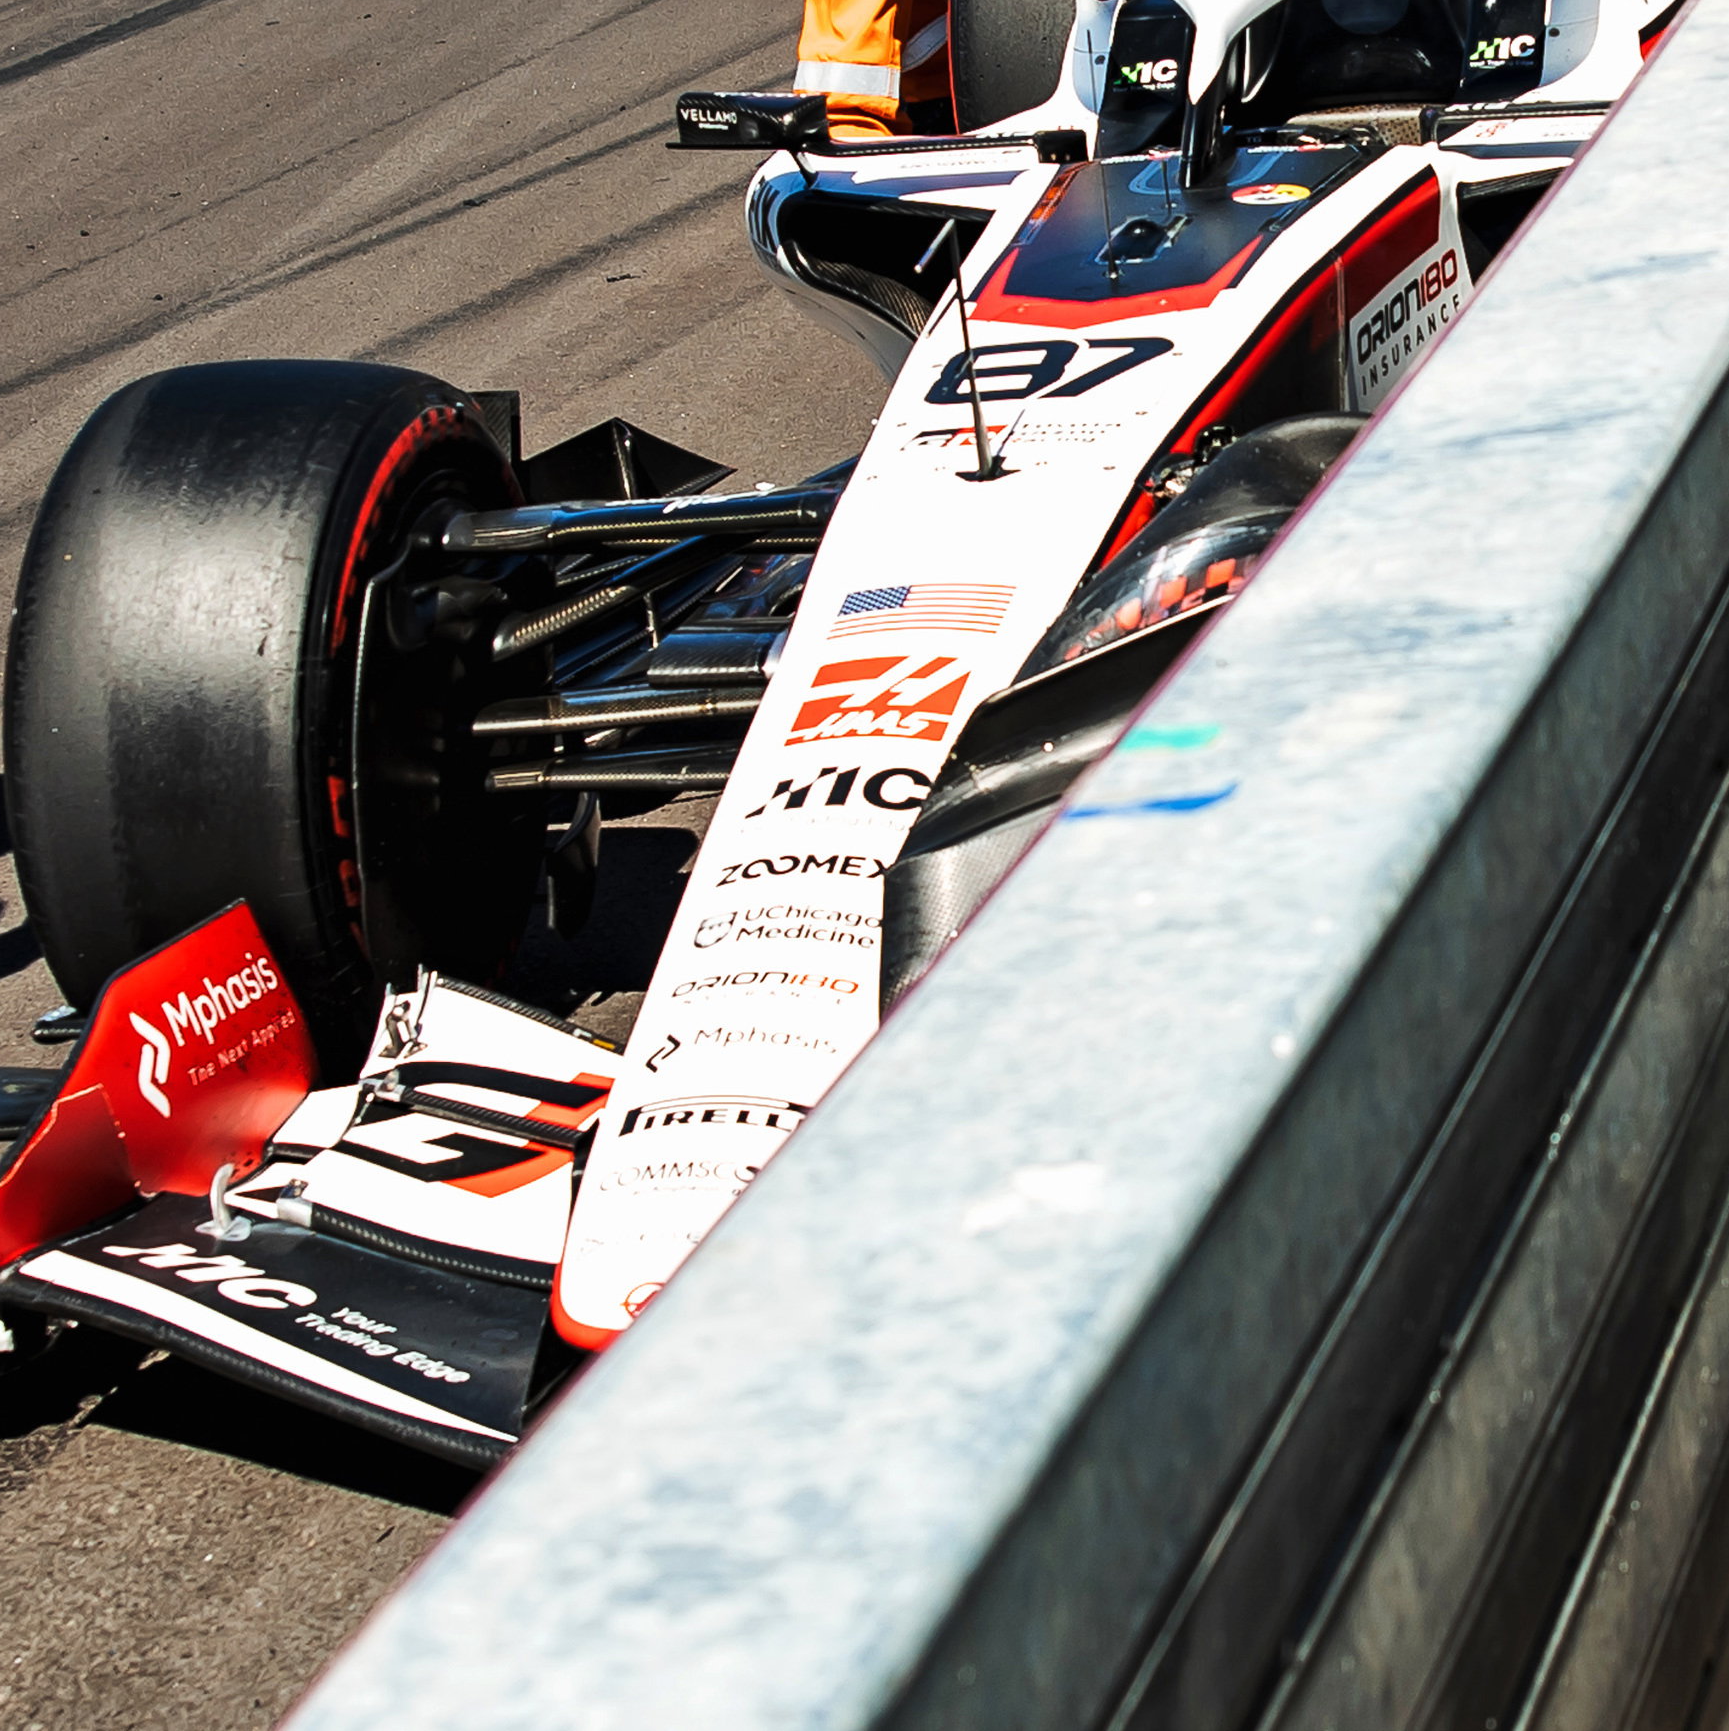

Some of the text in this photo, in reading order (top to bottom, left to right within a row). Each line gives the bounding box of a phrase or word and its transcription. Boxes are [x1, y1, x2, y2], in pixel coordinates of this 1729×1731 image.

[679, 106, 738, 126] VELLAMO
[1356, 247, 1458, 366] ORION180
[1360, 293, 1461, 396] INSURANCE
[924, 336, 1175, 405] 87
[792, 709, 952, 741] HAAS
[715, 854, 887, 888] ZOOMEX
[744, 904, 884, 929] UChicago
[735, 924, 875, 949] Medicine
[160, 951, 279, 1048] Mphasis
[671, 971, 860, 998] ORION180
[693, 1026, 838, 1055] Mphasis
[187, 1062, 217, 1086] The
[217, 1039, 248, 1068] Next
[618, 1094, 813, 1138] PIRELL
[599, 1161, 763, 1192] COMMSCO
[330, 1307, 398, 1335] Your
[294, 1312, 471, 1384] Trading Edge
